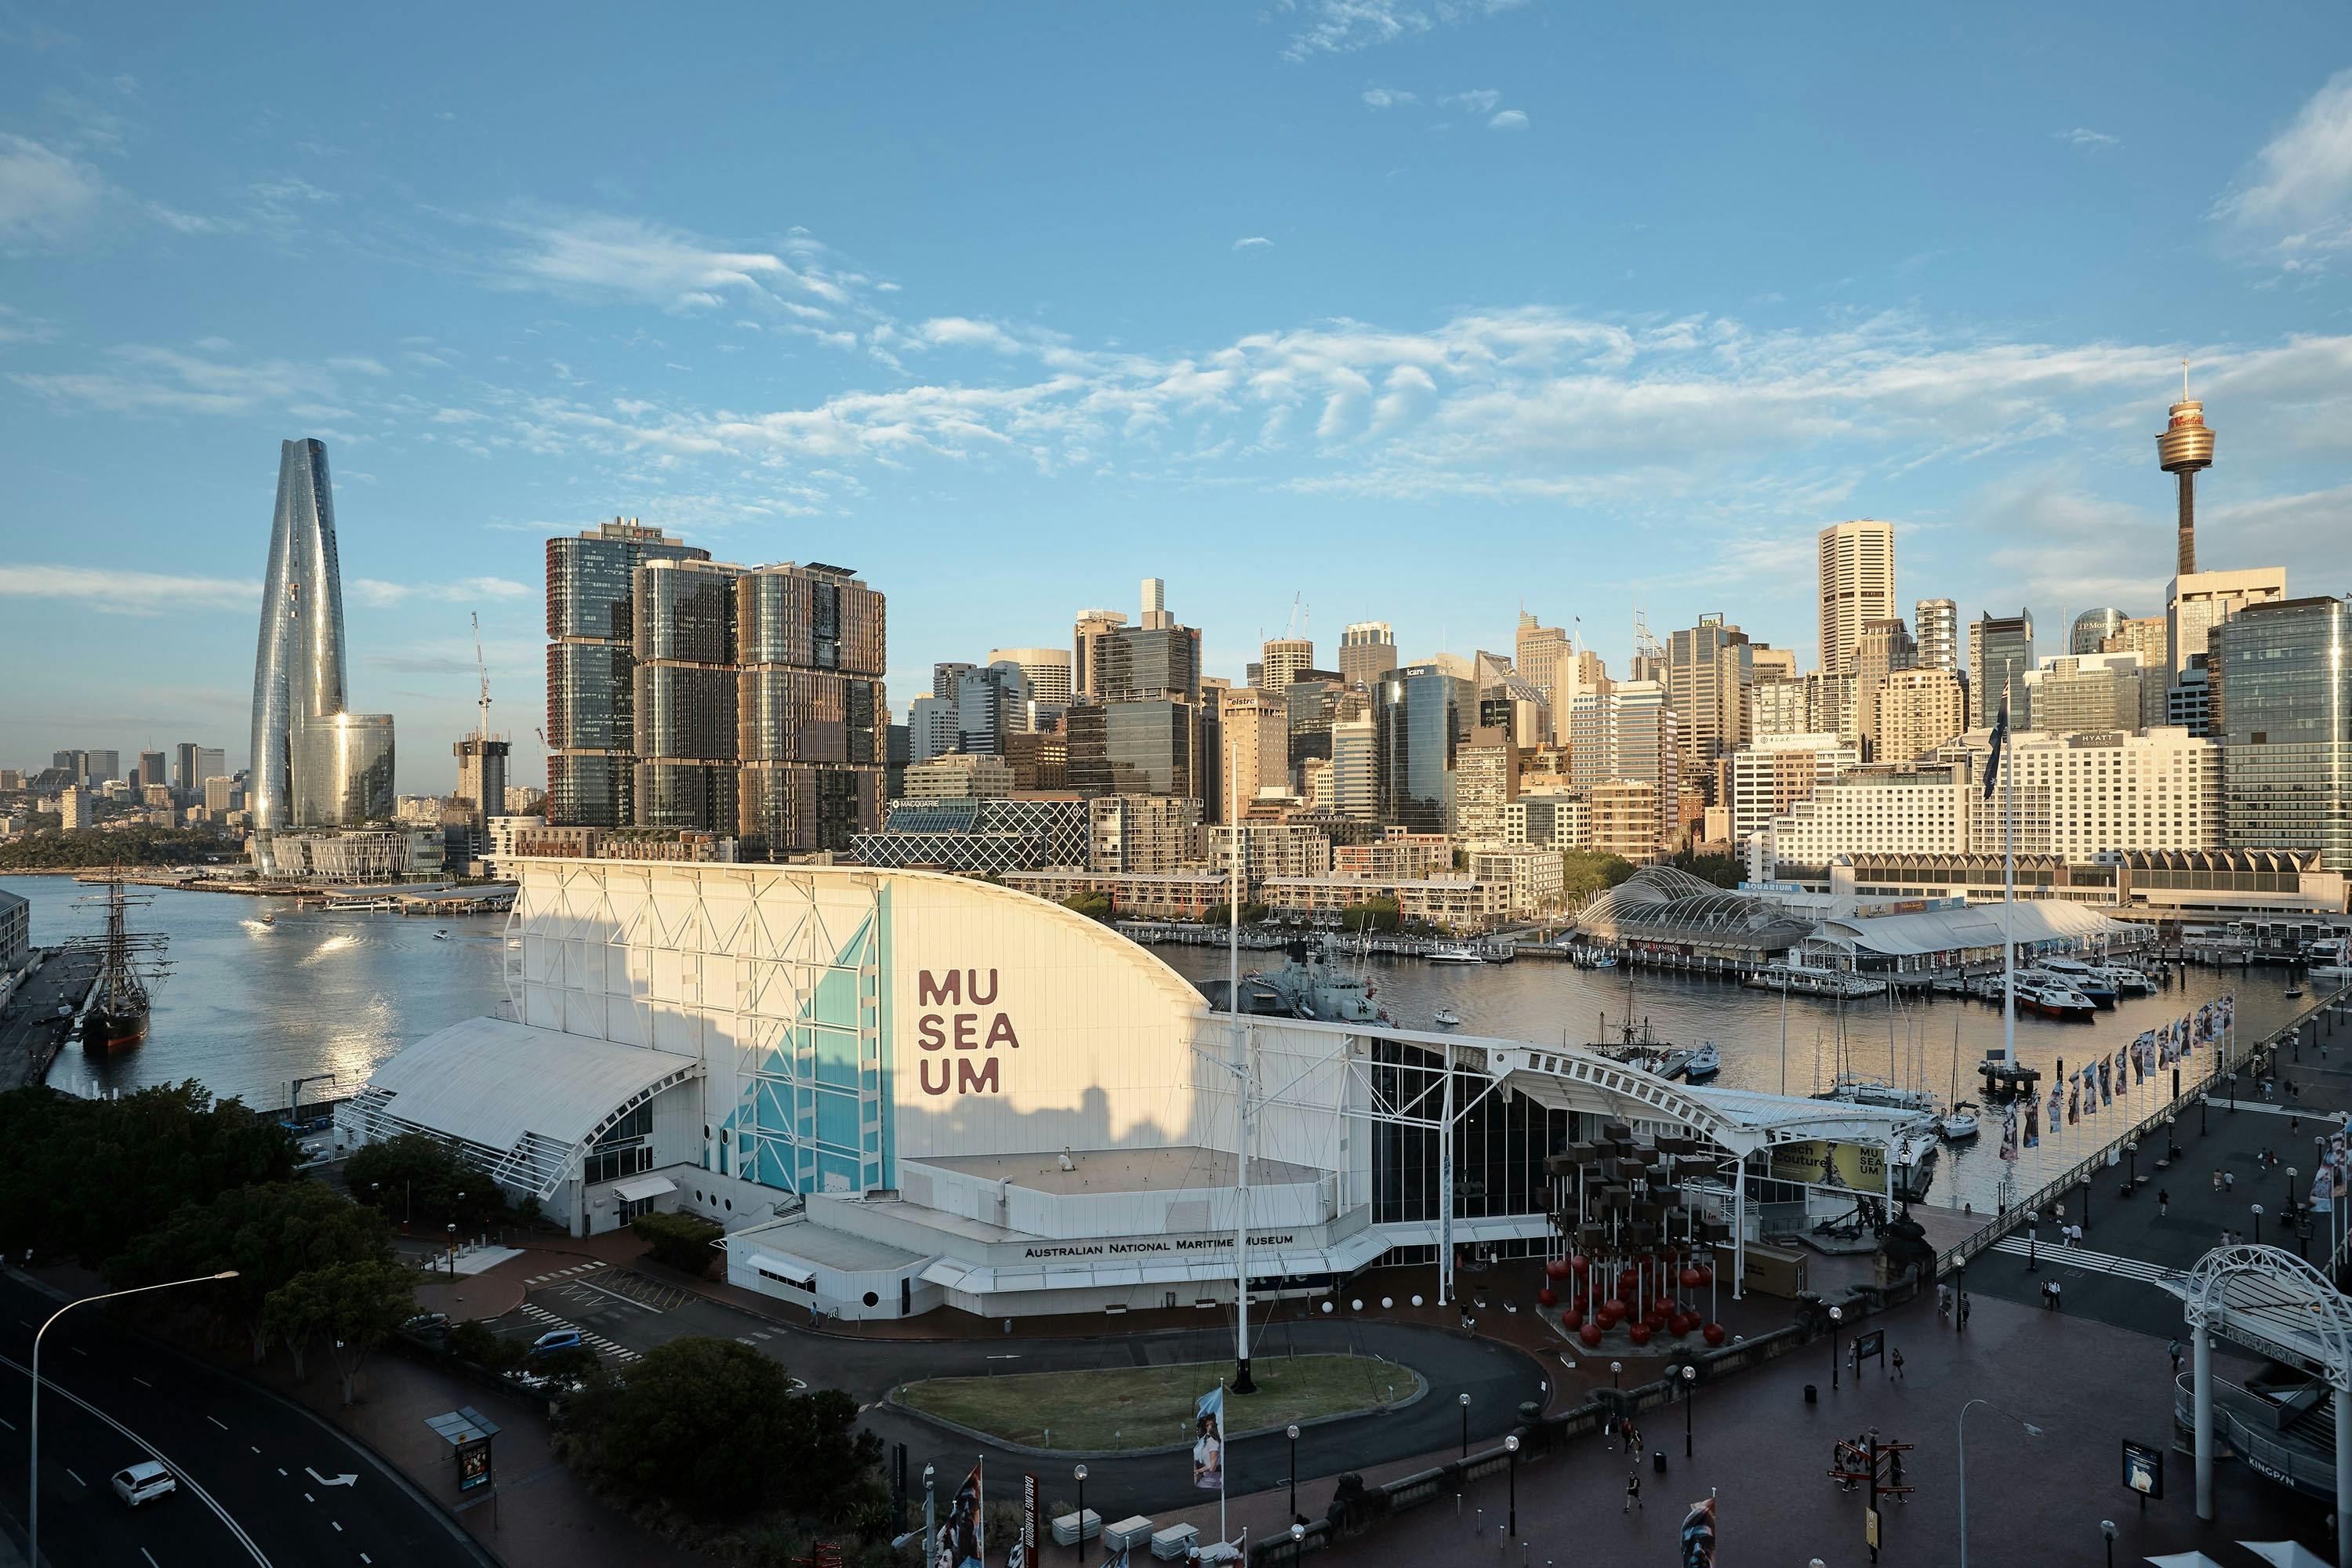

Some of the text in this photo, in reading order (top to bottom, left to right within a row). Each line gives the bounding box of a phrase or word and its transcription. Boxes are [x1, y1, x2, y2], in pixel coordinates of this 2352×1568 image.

[1226, 698, 1255, 708] Telstra
[1744, 883, 1793, 892] AQUARIUM
[1661, 943, 1681, 952] SHINE
[919, 968, 998, 1006] MU
[918, 1013, 1019, 1051] SEA
[920, 1057, 999, 1095] UM
[1860, 1148, 1878, 1157] MU
[1774, 1152, 1826, 1168] Couture
[1860, 1156, 1883, 1167] SEA
[1860, 1165, 1878, 1175] UM
[2227, 1328, 2306, 1369] HARBOURSIDE
[1025, 1475, 1034, 1548] DARLING HARBOUR
